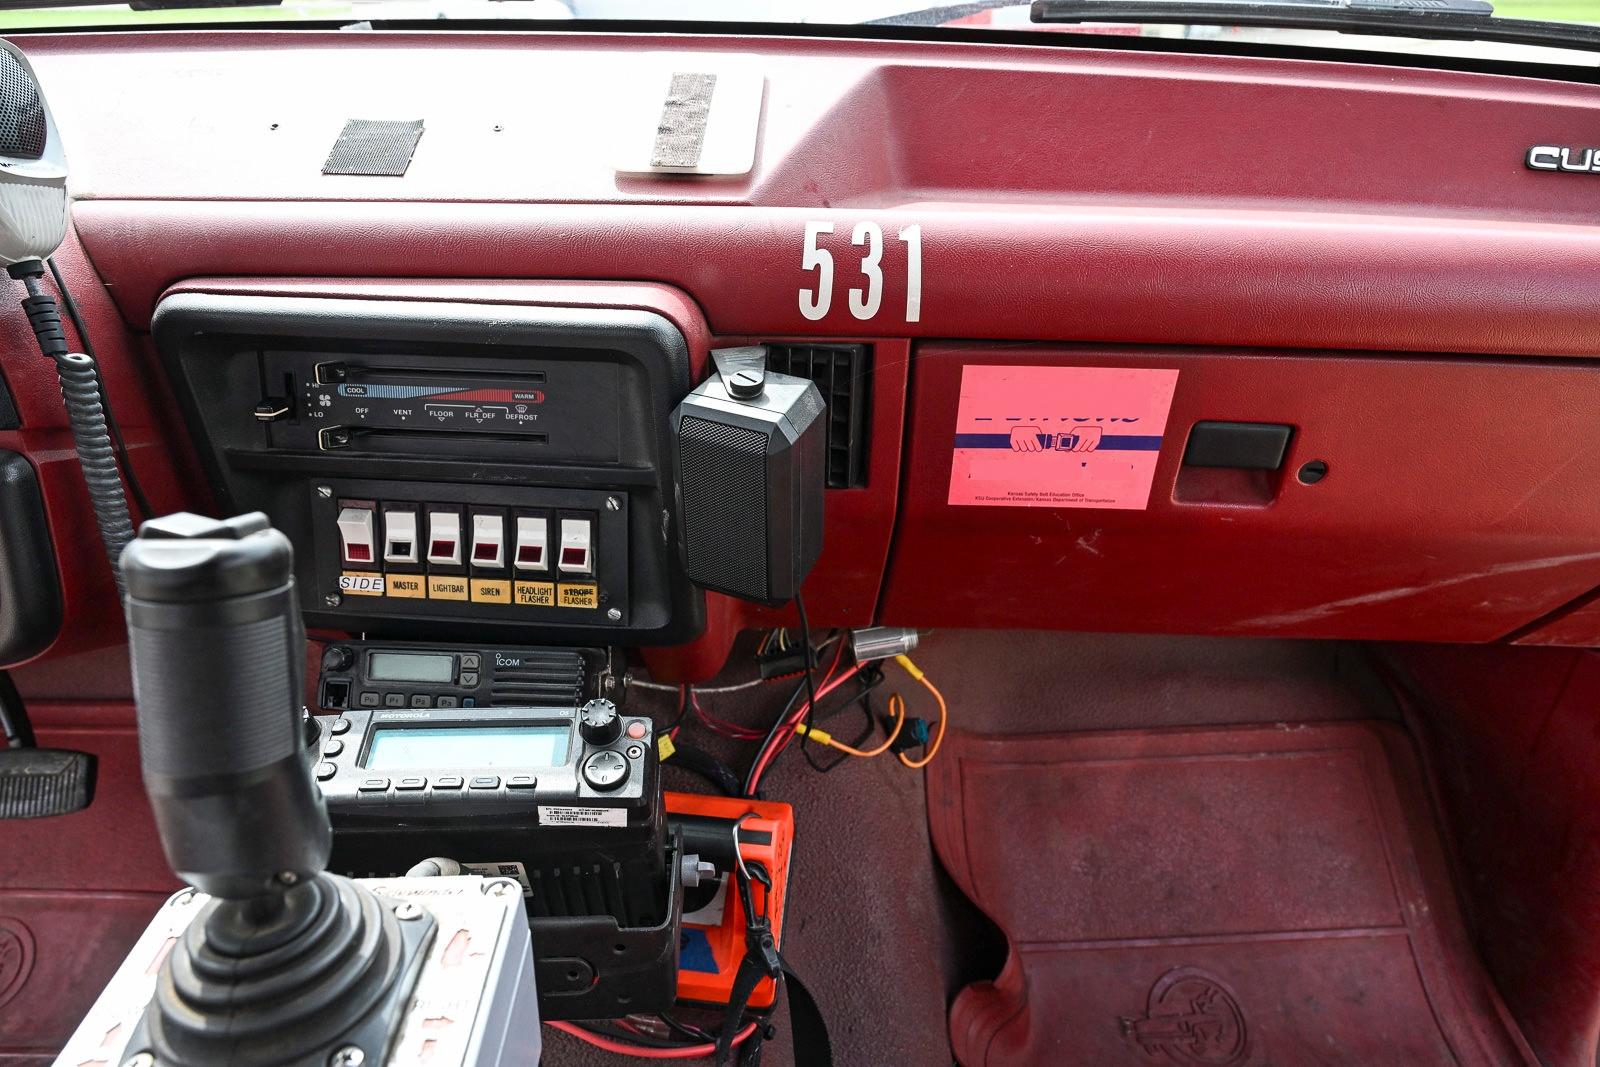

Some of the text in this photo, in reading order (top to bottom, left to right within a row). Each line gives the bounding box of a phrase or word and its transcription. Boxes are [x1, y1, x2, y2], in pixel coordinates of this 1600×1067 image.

[1529, 146, 1600, 172] CU
[798, 220, 922, 322] 531
[347, 386, 365, 394] COOL
[429, 410, 454, 418] FLOOR
[340, 576, 383, 590] SIDE
[392, 581, 419, 591] MASTER
[432, 584, 465, 594] LIGHTBAR
[480, 587, 500, 597] SIREN
[516, 586, 553, 597] HEADLIGHT
[563, 588, 594, 597] STROBE
[520, 595, 550, 604] FLASHER
[563, 596, 593, 606] FLASHER
